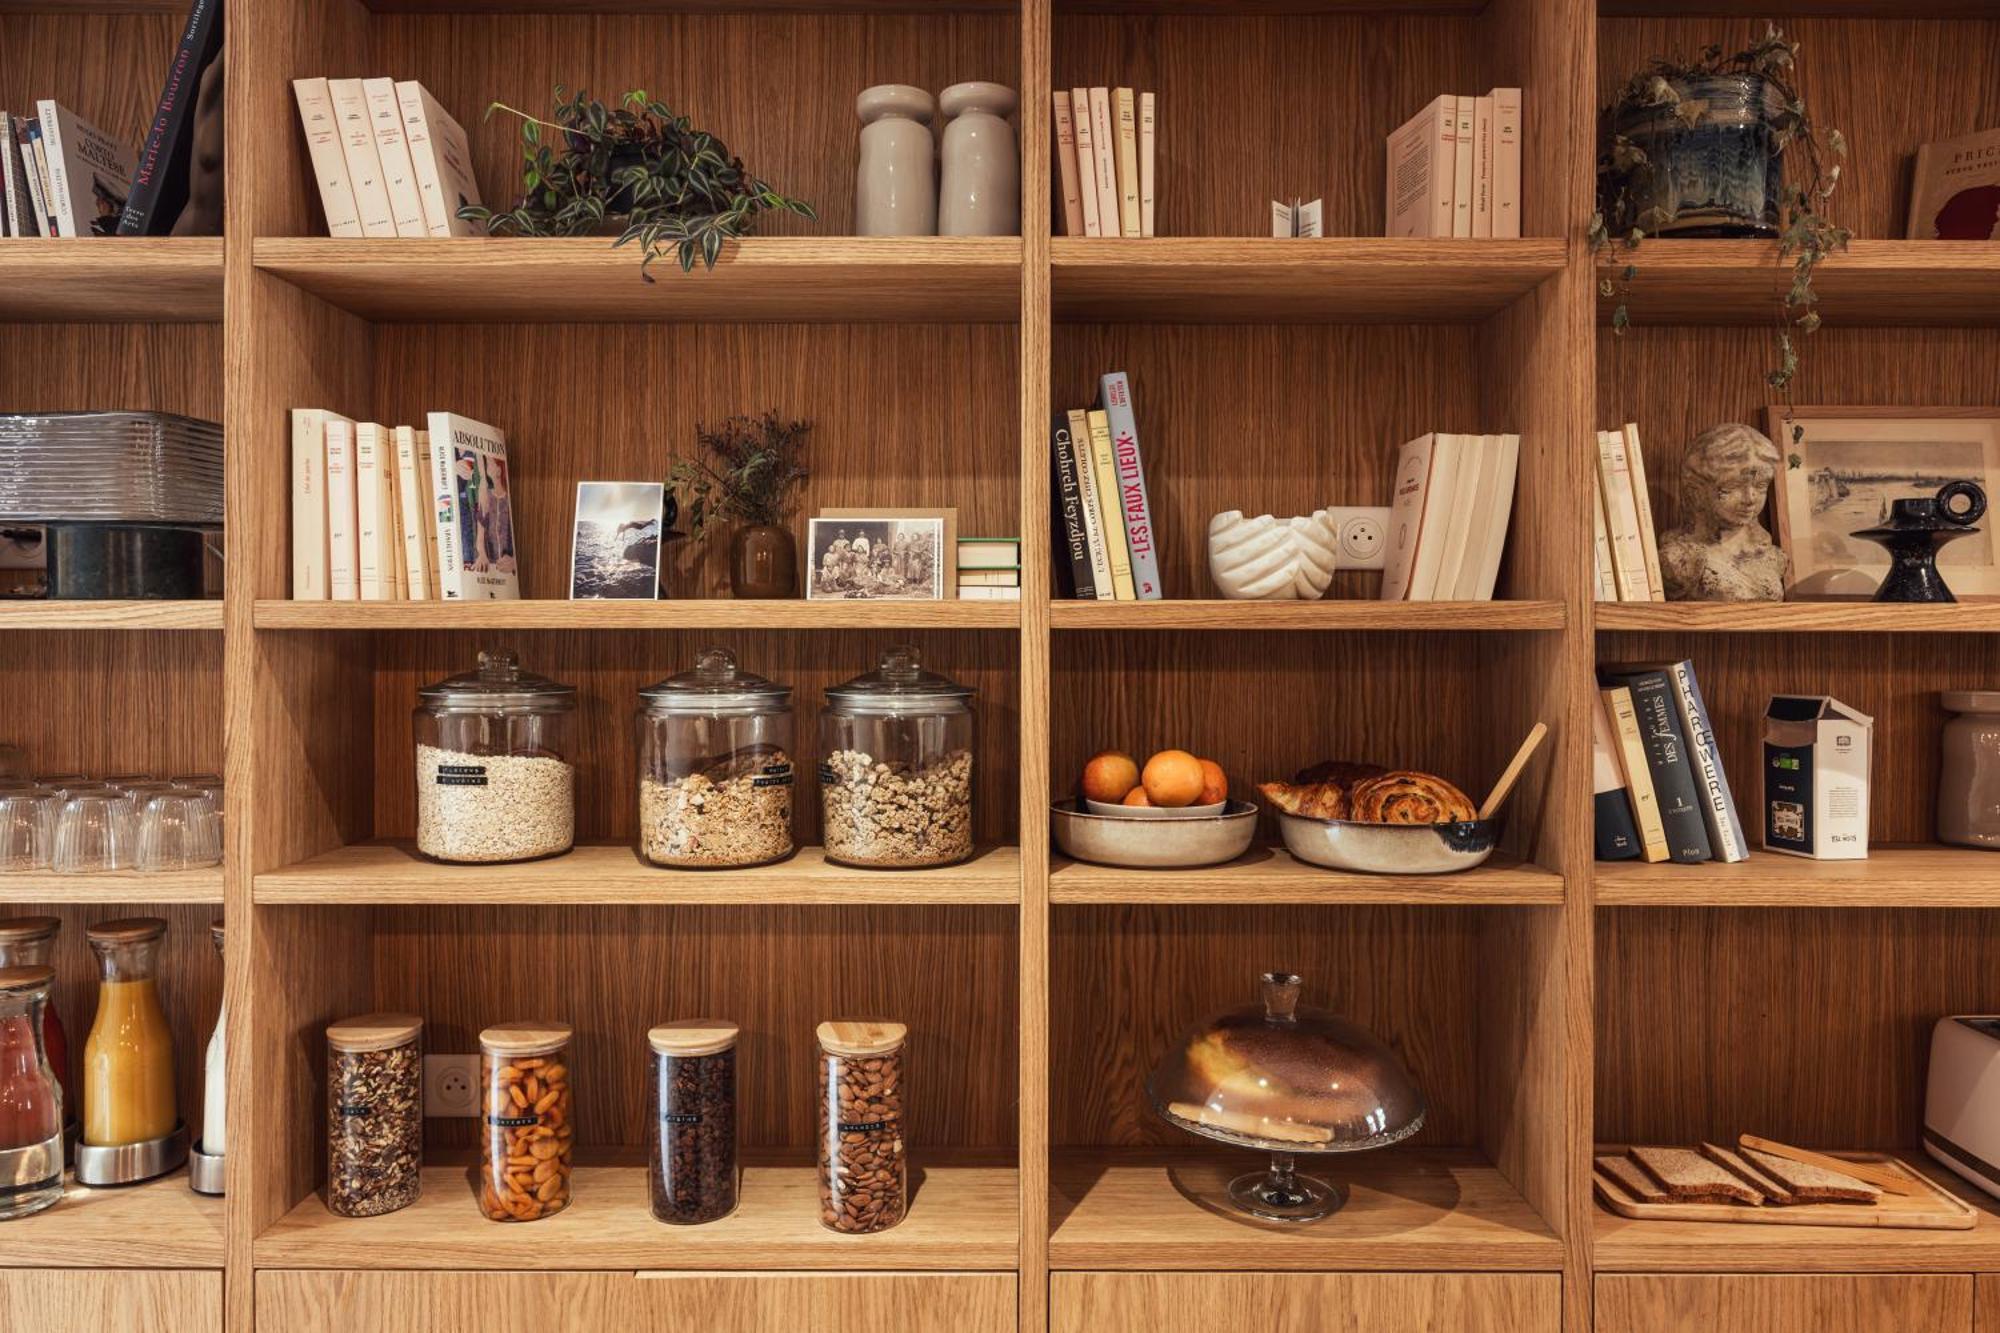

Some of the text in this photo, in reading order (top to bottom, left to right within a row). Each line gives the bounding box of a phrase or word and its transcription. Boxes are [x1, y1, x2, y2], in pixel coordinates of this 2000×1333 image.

[453, 429, 506, 455] ABSOLUTION
[1055, 428, 1085, 560] Chohreh Feyzdjou
[1116, 435, 1151, 554] LES FAUX LIEUX
